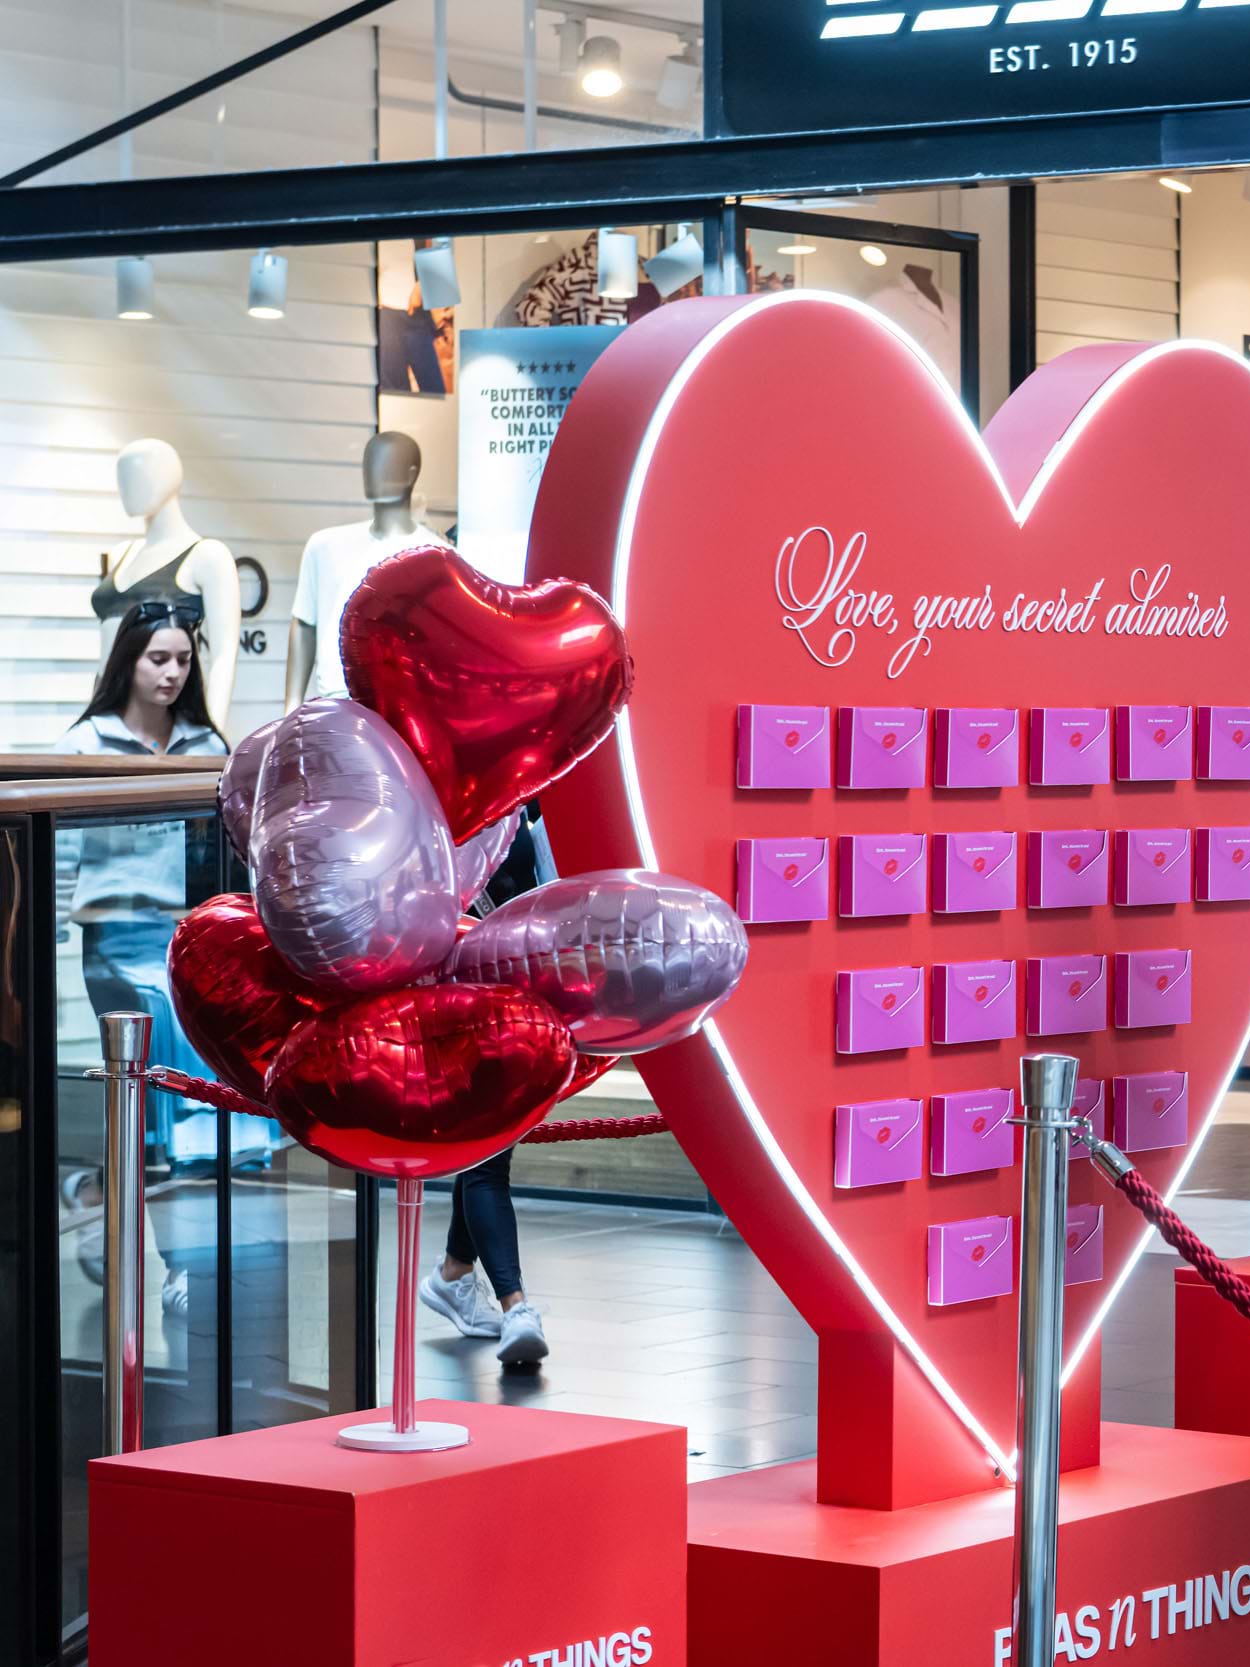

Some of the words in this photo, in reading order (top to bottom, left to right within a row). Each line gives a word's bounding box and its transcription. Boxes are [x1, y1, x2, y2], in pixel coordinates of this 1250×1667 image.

[989, 45, 1050, 73] EST.
[1068, 38, 1137, 67] 1915
[507, 422, 524, 436] IN
[527, 421, 554, 436] ALL
[488, 439, 535, 454] RIGHT
[774, 526, 898, 667] Love,
[887, 584, 996, 679] your
[1002, 577, 1105, 633] secret
[1105, 563, 1229, 638] admirer
